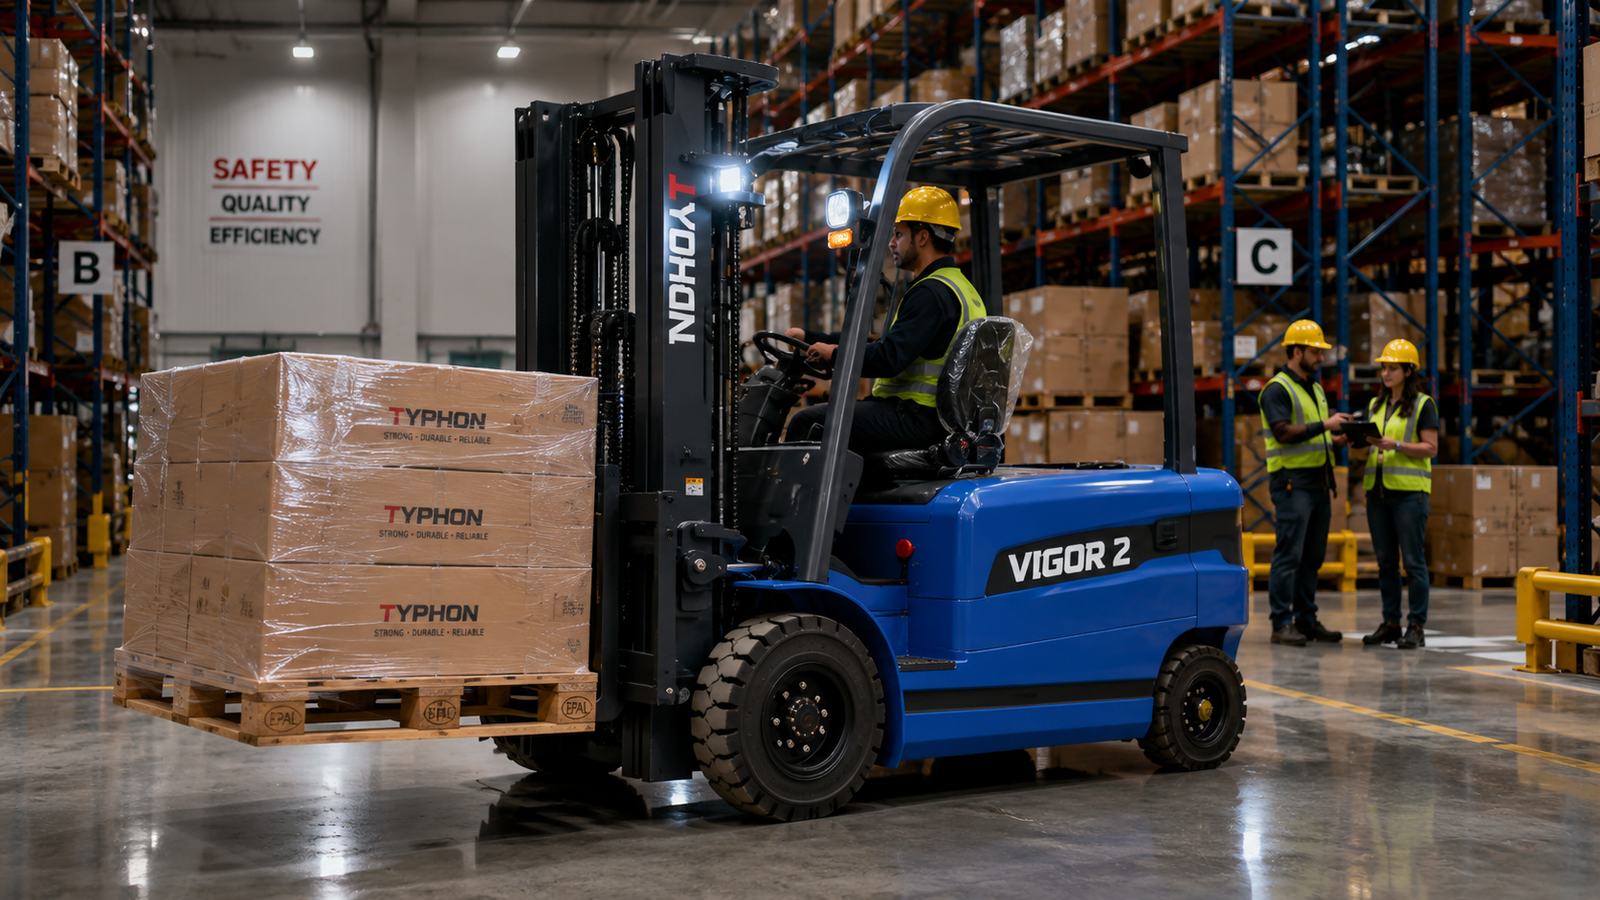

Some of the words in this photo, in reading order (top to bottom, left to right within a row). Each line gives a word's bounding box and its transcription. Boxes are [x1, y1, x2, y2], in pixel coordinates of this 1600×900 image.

[213, 158, 317, 181] SAFETY
[222, 194, 310, 214] QUALITY
[210, 227, 321, 245] EFFICIENCY
[1251, 238, 1278, 275] C
[74, 251, 100, 285] B
[389, 407, 487, 430] TYPHON
[383, 431, 413, 441] STRONG
[420, 433, 452, 443] DURABLE
[384, 505, 483, 526] TYPHON
[379, 529, 409, 538] STRONG
[416, 530, 449, 540] DURABLE
[1008, 540, 1106, 583] VIGOR
[1112, 536, 1131, 567] 2
[379, 604, 479, 622] TYPHON
[374, 628, 404, 637] STRONG
[412, 628, 445, 637] DURABLE
